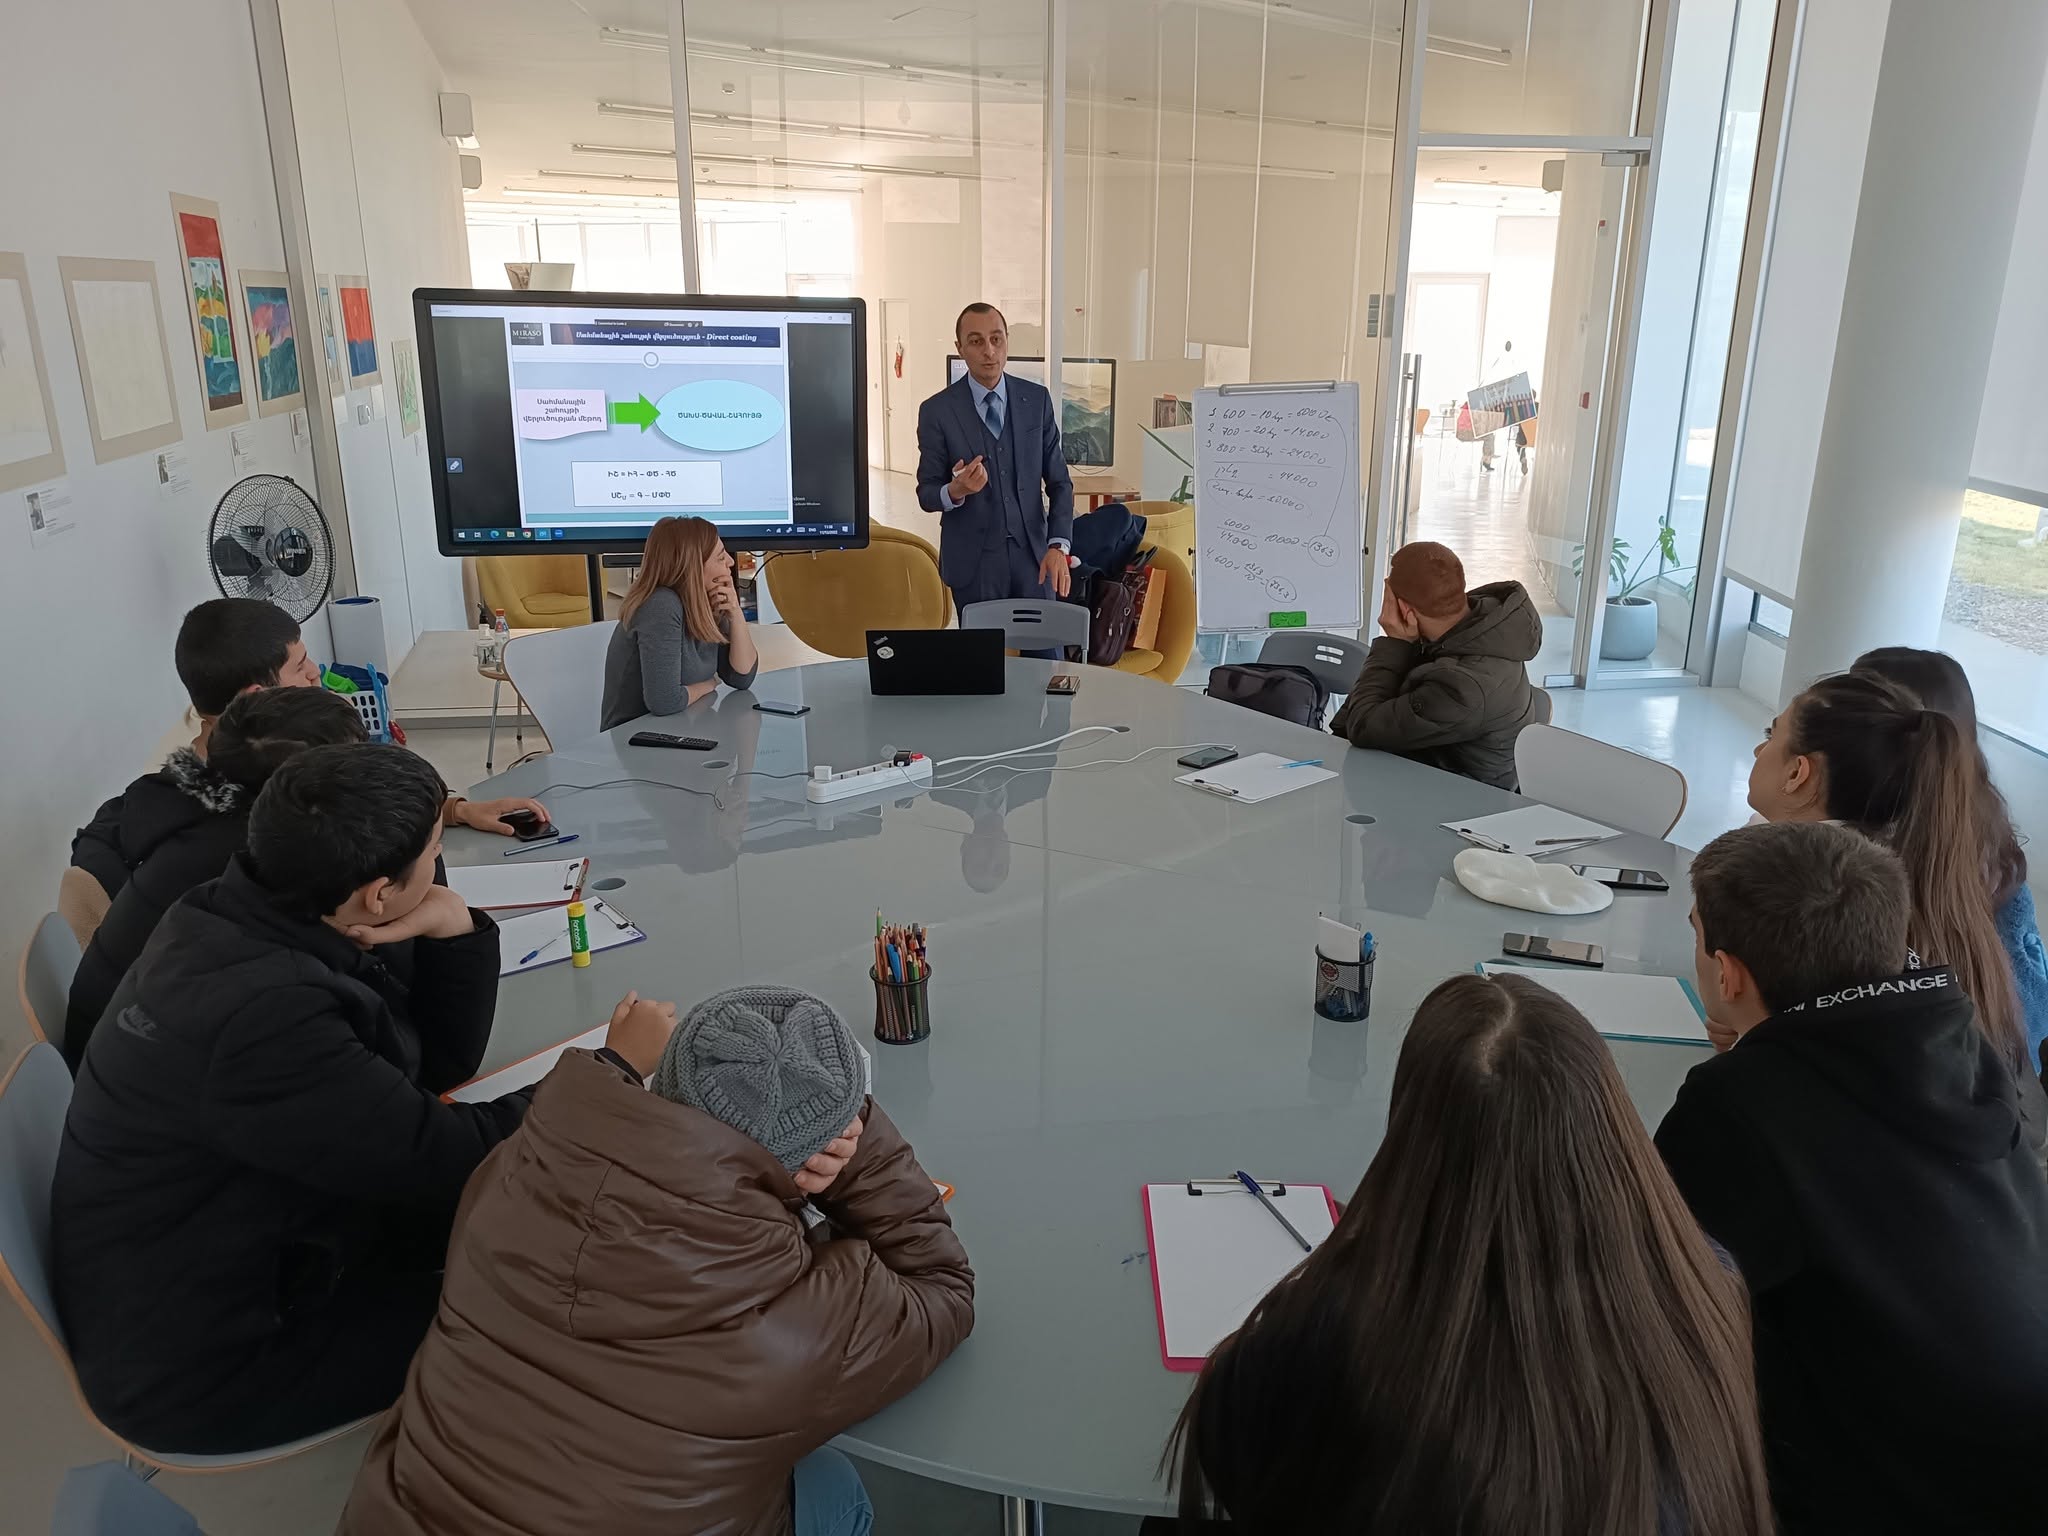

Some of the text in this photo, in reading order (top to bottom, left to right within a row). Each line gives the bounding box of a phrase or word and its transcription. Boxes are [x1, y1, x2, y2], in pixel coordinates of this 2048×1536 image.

[512, 329, 542, 337] MIRASO
[730, 334, 757, 342] costing
[537, 398, 586, 406] Սահմանային
[545, 407, 580, 415] շահույթի
[1222, 409, 1246, 419] 600
[1222, 426, 1241, 436] 700
[1816, 974, 1949, 1009] EXCHANGE
[127, 1002, 158, 1032] NIKE
